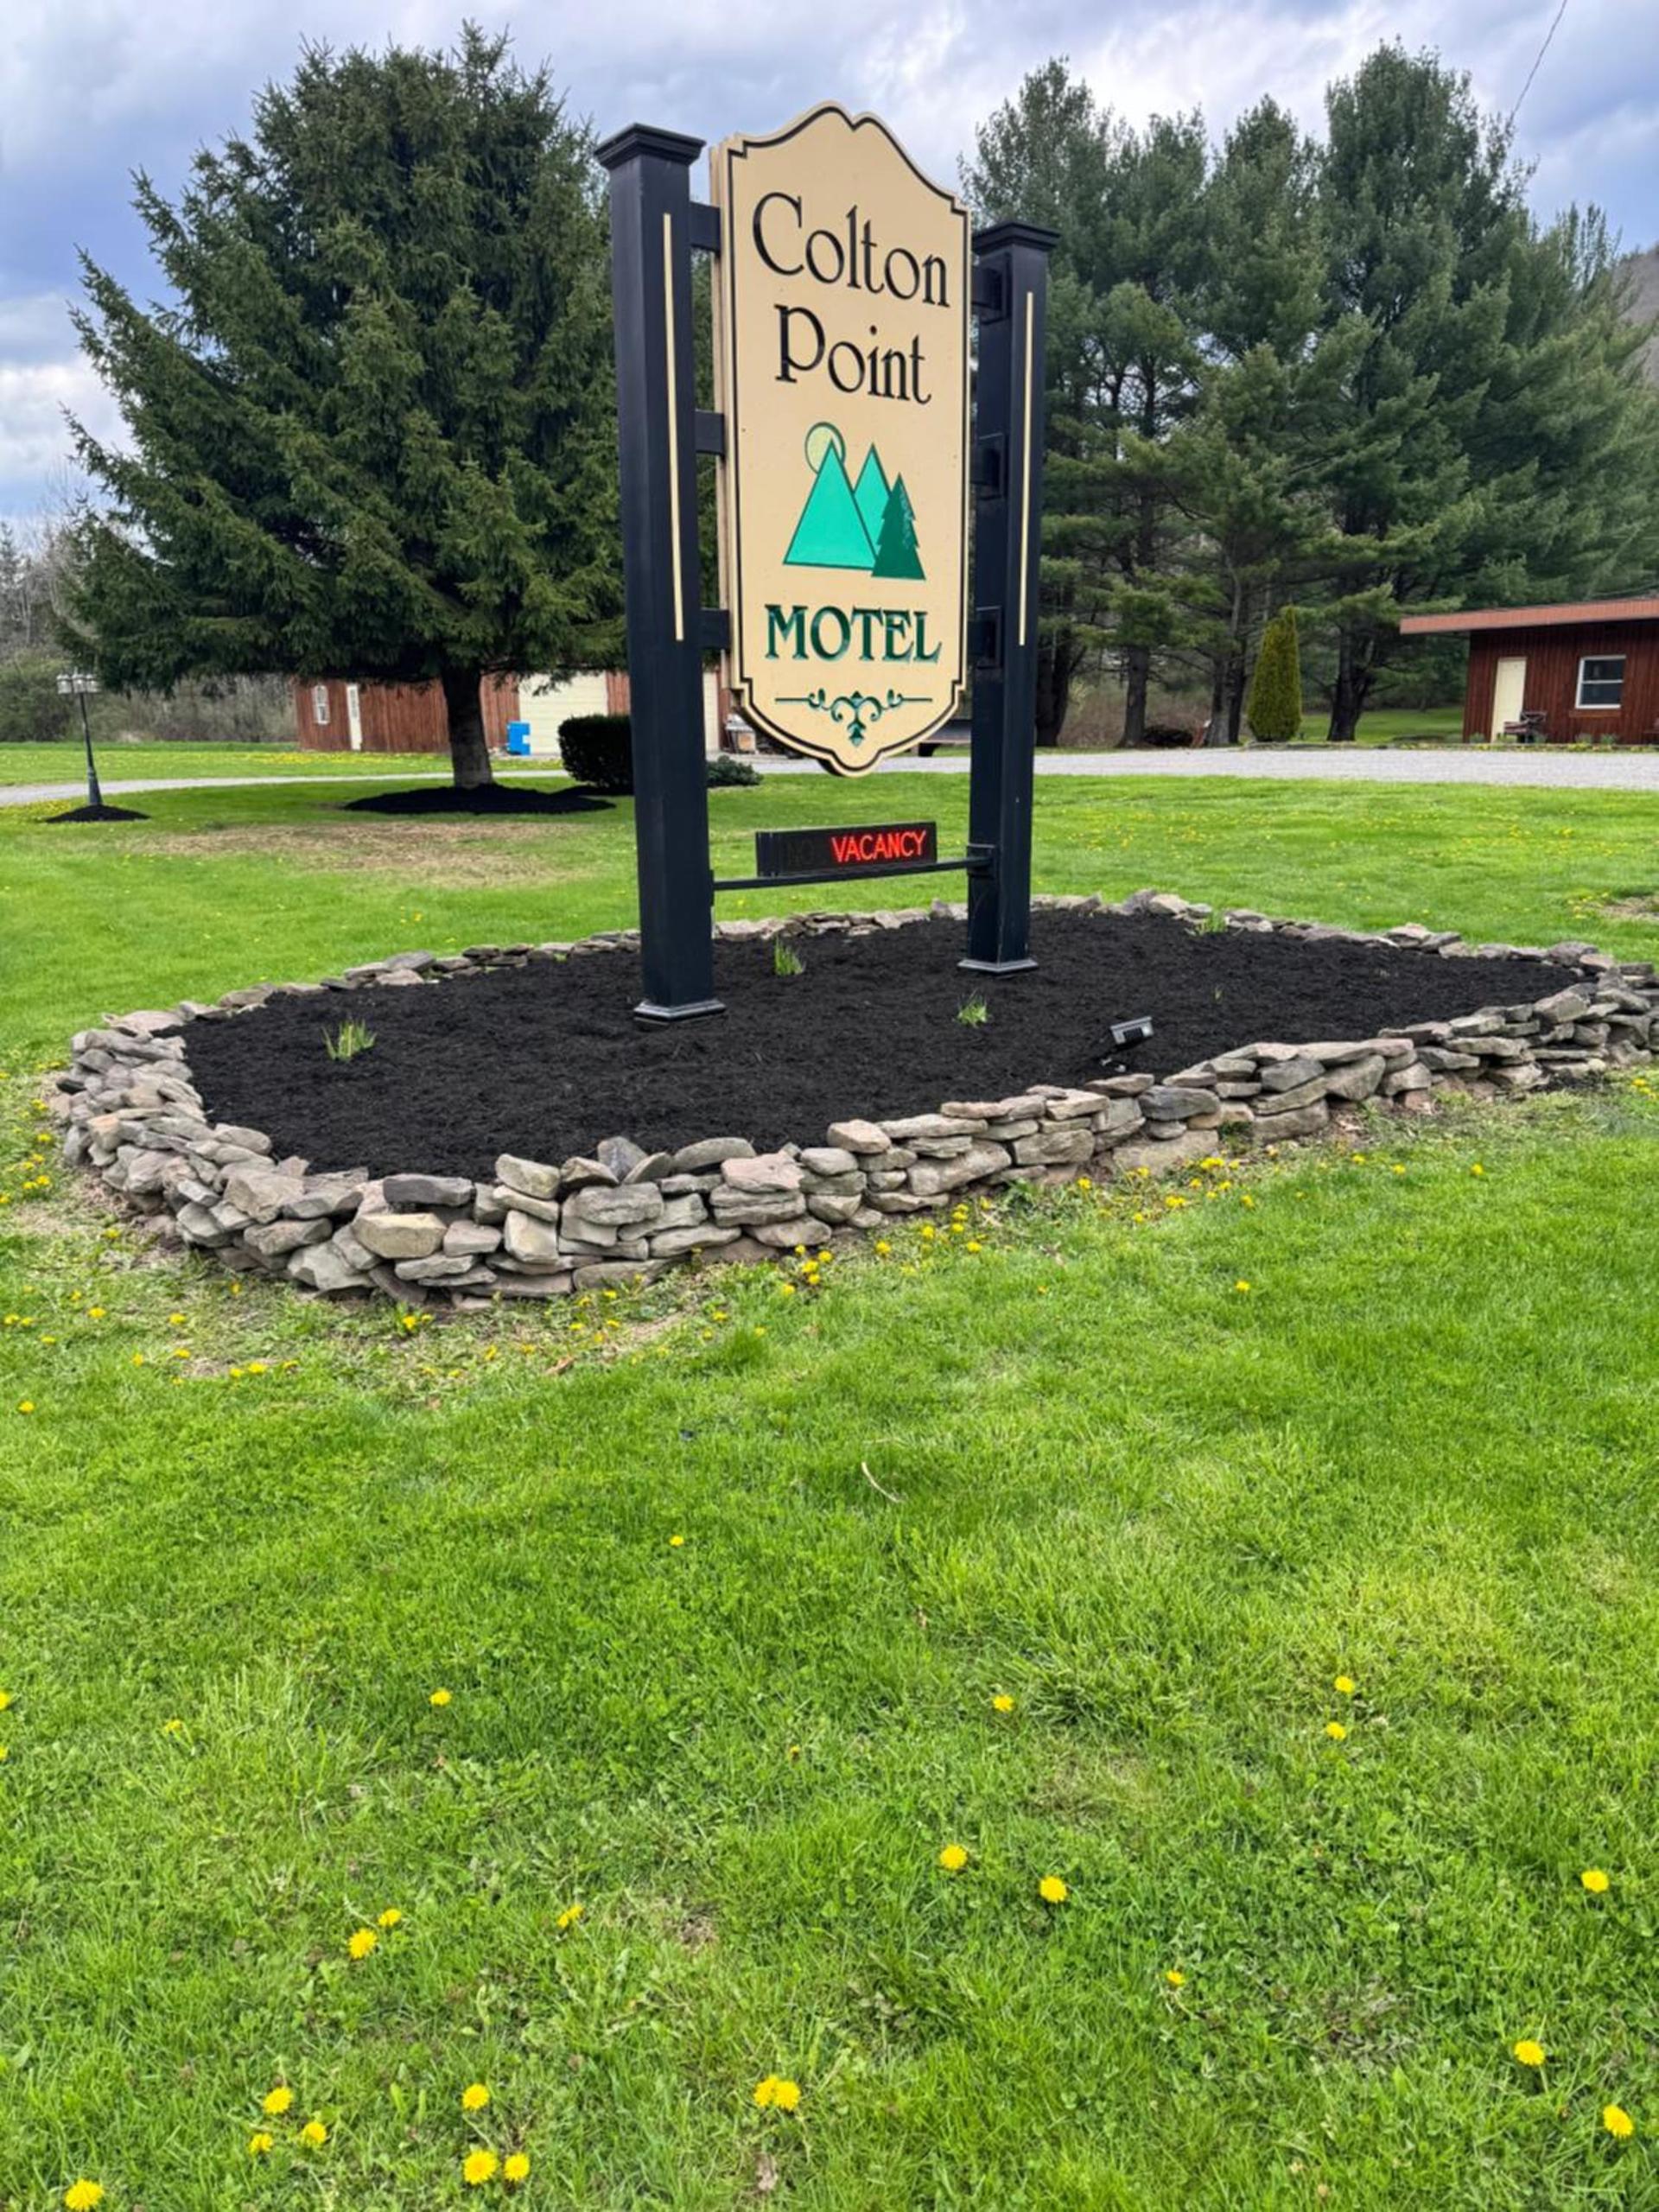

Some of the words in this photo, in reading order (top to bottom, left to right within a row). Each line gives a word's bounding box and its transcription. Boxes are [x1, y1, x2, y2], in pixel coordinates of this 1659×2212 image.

[752, 191, 951, 308] Colton
[773, 303, 932, 404] Point
[764, 604, 941, 664] MOTEL
[831, 830, 927, 863] VACANCY
